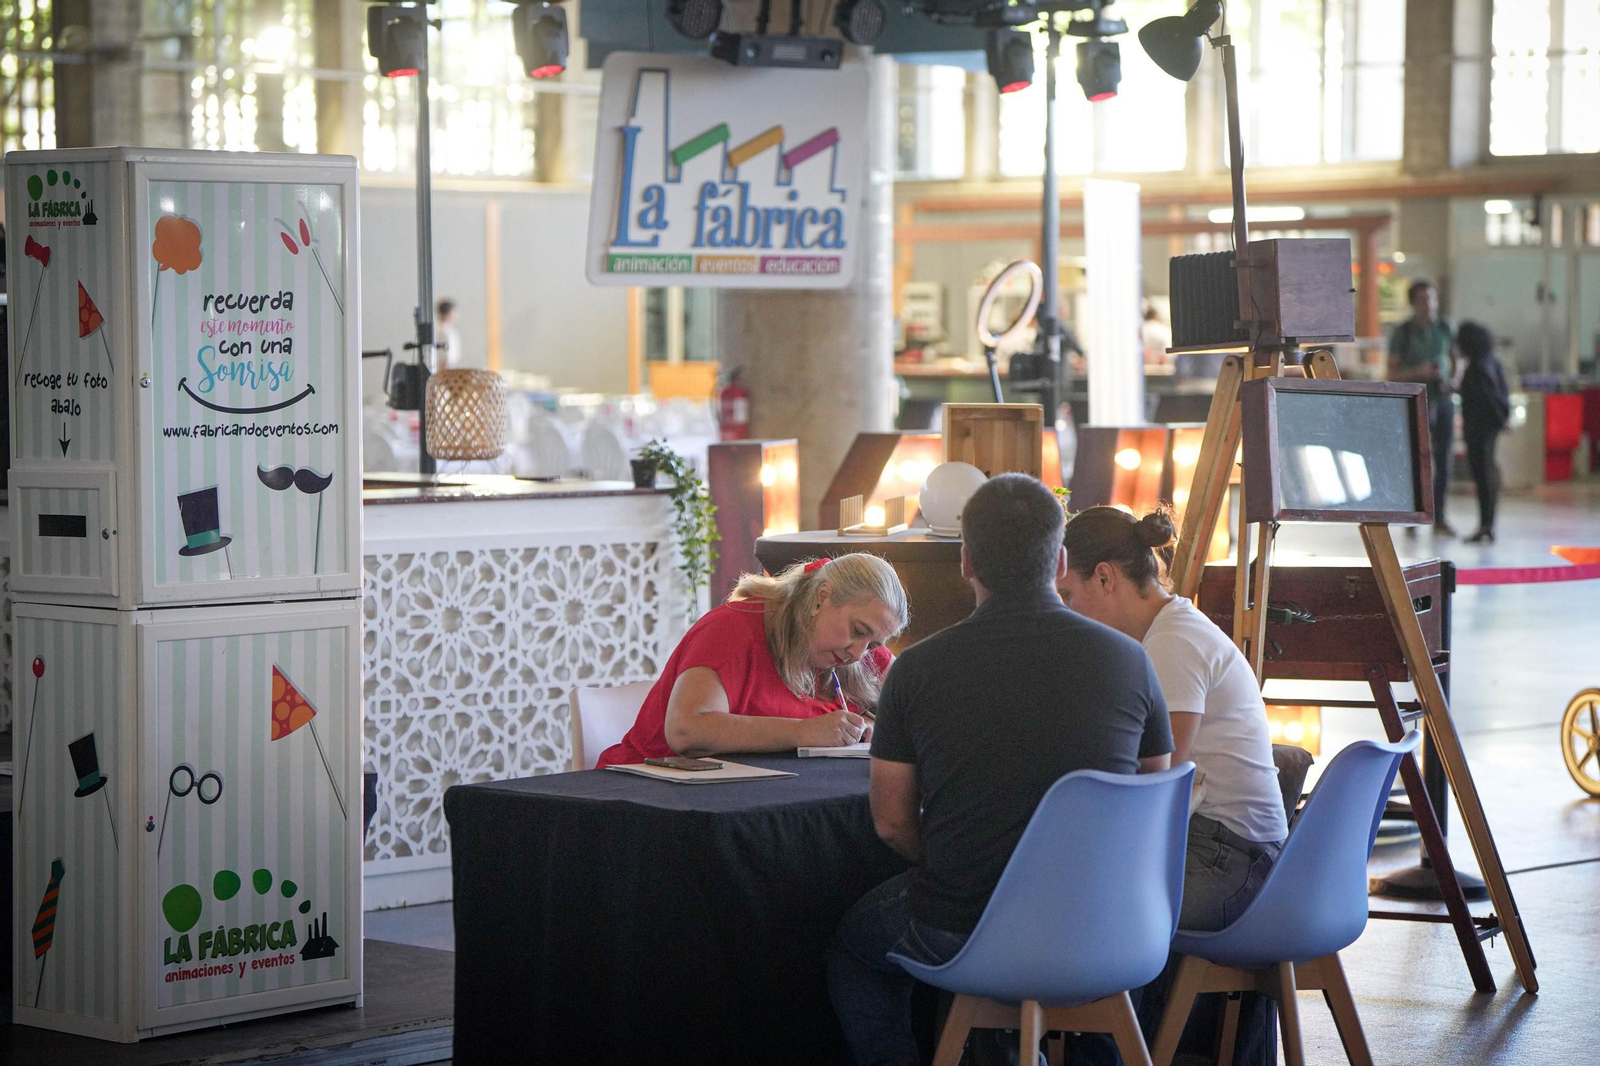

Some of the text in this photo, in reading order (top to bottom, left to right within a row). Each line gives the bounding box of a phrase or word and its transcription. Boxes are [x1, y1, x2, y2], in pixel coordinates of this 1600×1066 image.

[611, 125, 847, 249] La fábrica
[28, 199, 81, 218] LA FÁBRICA
[29, 219, 81, 230] animaciones y eventos
[613, 255, 691, 272] animación
[700, 257, 757, 273] eventos
[203, 290, 294, 314] recuerda
[200, 316, 295, 338] este momento
[218, 337, 293, 357] con una
[197, 345, 294, 394] Sonrisa
[24, 371, 108, 390] recoge tu foto
[51, 398, 81, 416] abajo
[162, 422, 339, 439] www.fabricandoeventos.com
[163, 918, 298, 966] LA FÁBRICA
[164, 952, 296, 983] animaciones y eventos
